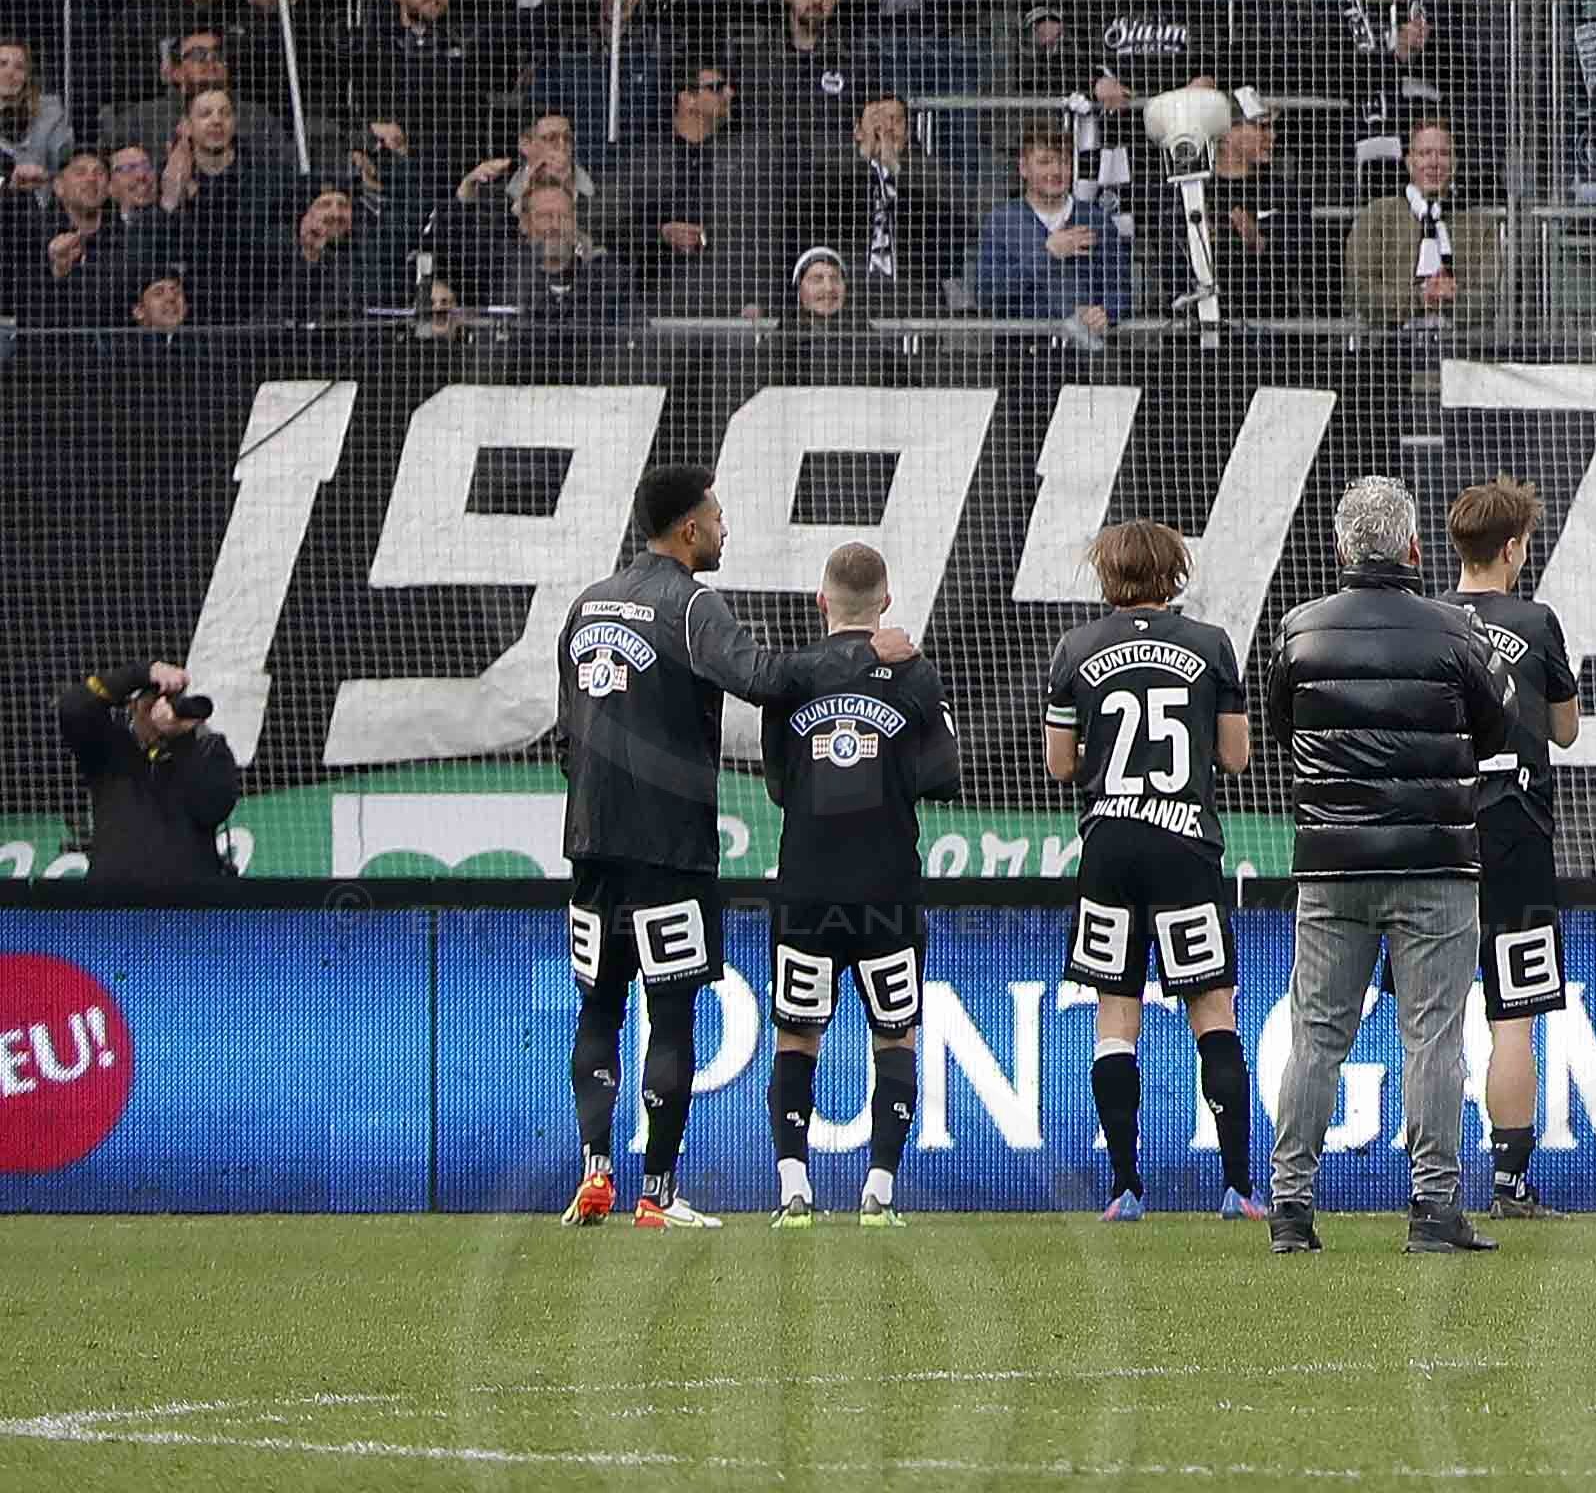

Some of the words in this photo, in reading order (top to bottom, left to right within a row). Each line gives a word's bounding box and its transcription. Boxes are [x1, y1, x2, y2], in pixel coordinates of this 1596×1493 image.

[186, 380, 1337, 766] 1994
[573, 626, 653, 666] PUNTIGAMER
[1088, 643, 1200, 682] PUNTIGAMER
[797, 697, 904, 734] PUNTIGAMER
[1100, 686, 1191, 797] 25
